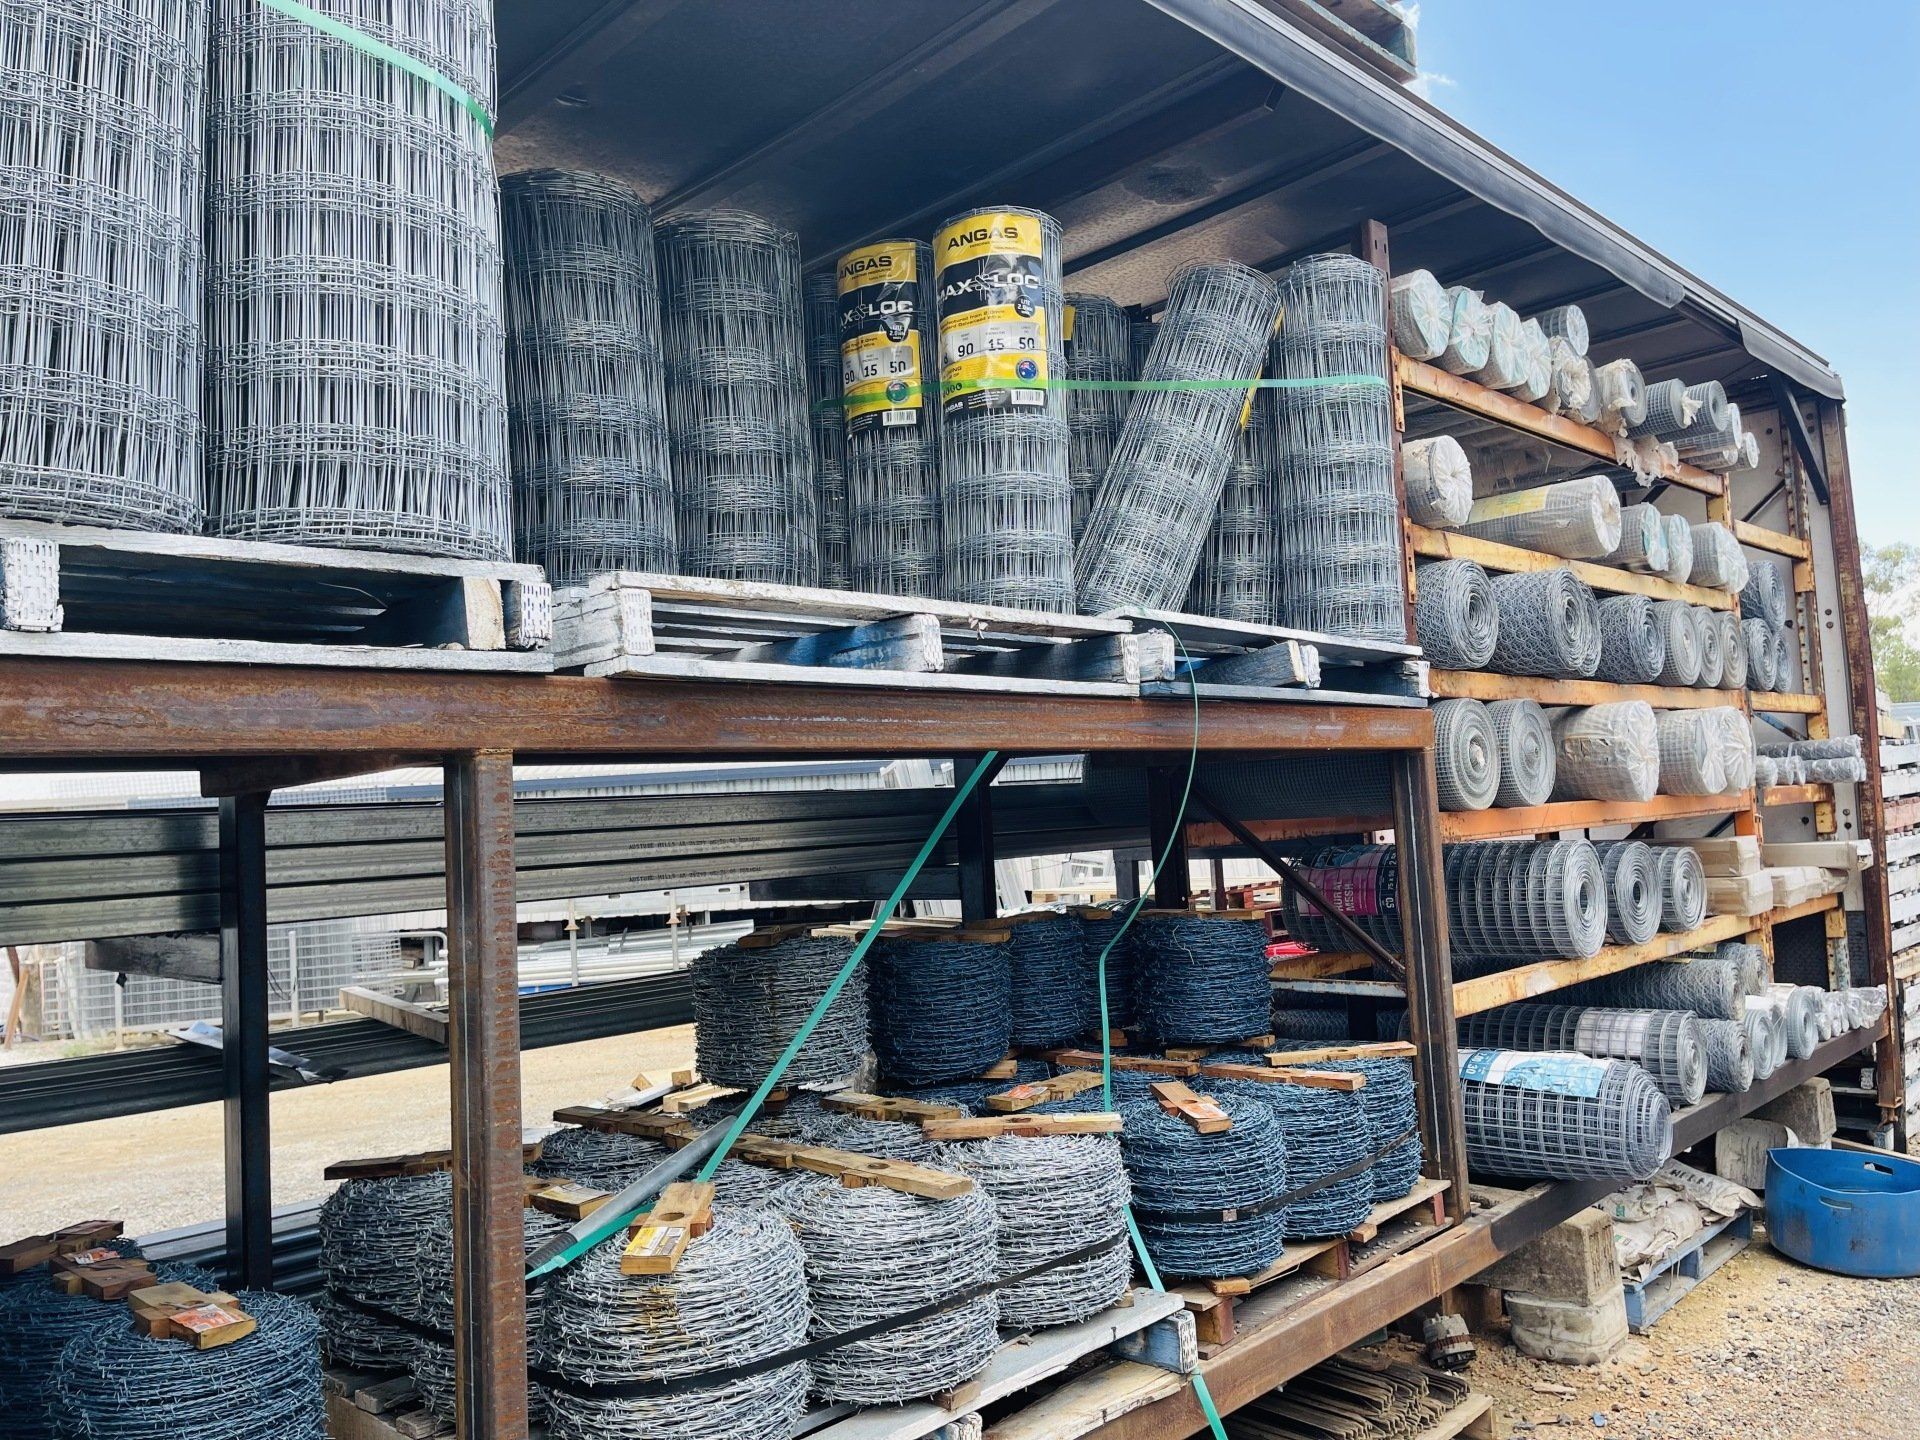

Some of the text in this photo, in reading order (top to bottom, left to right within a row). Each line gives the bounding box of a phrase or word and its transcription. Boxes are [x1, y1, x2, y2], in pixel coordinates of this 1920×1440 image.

[947, 227, 1018, 251] ANGAS
[957, 342, 974, 358] 90
[988, 338, 1005, 352] 15
[1018, 336, 1035, 350] 50
[844, 369, 855, 385] 90
[863, 363, 878, 378] 15
[889, 360, 907, 374] 50
[1345, 882, 1355, 912] MESH
